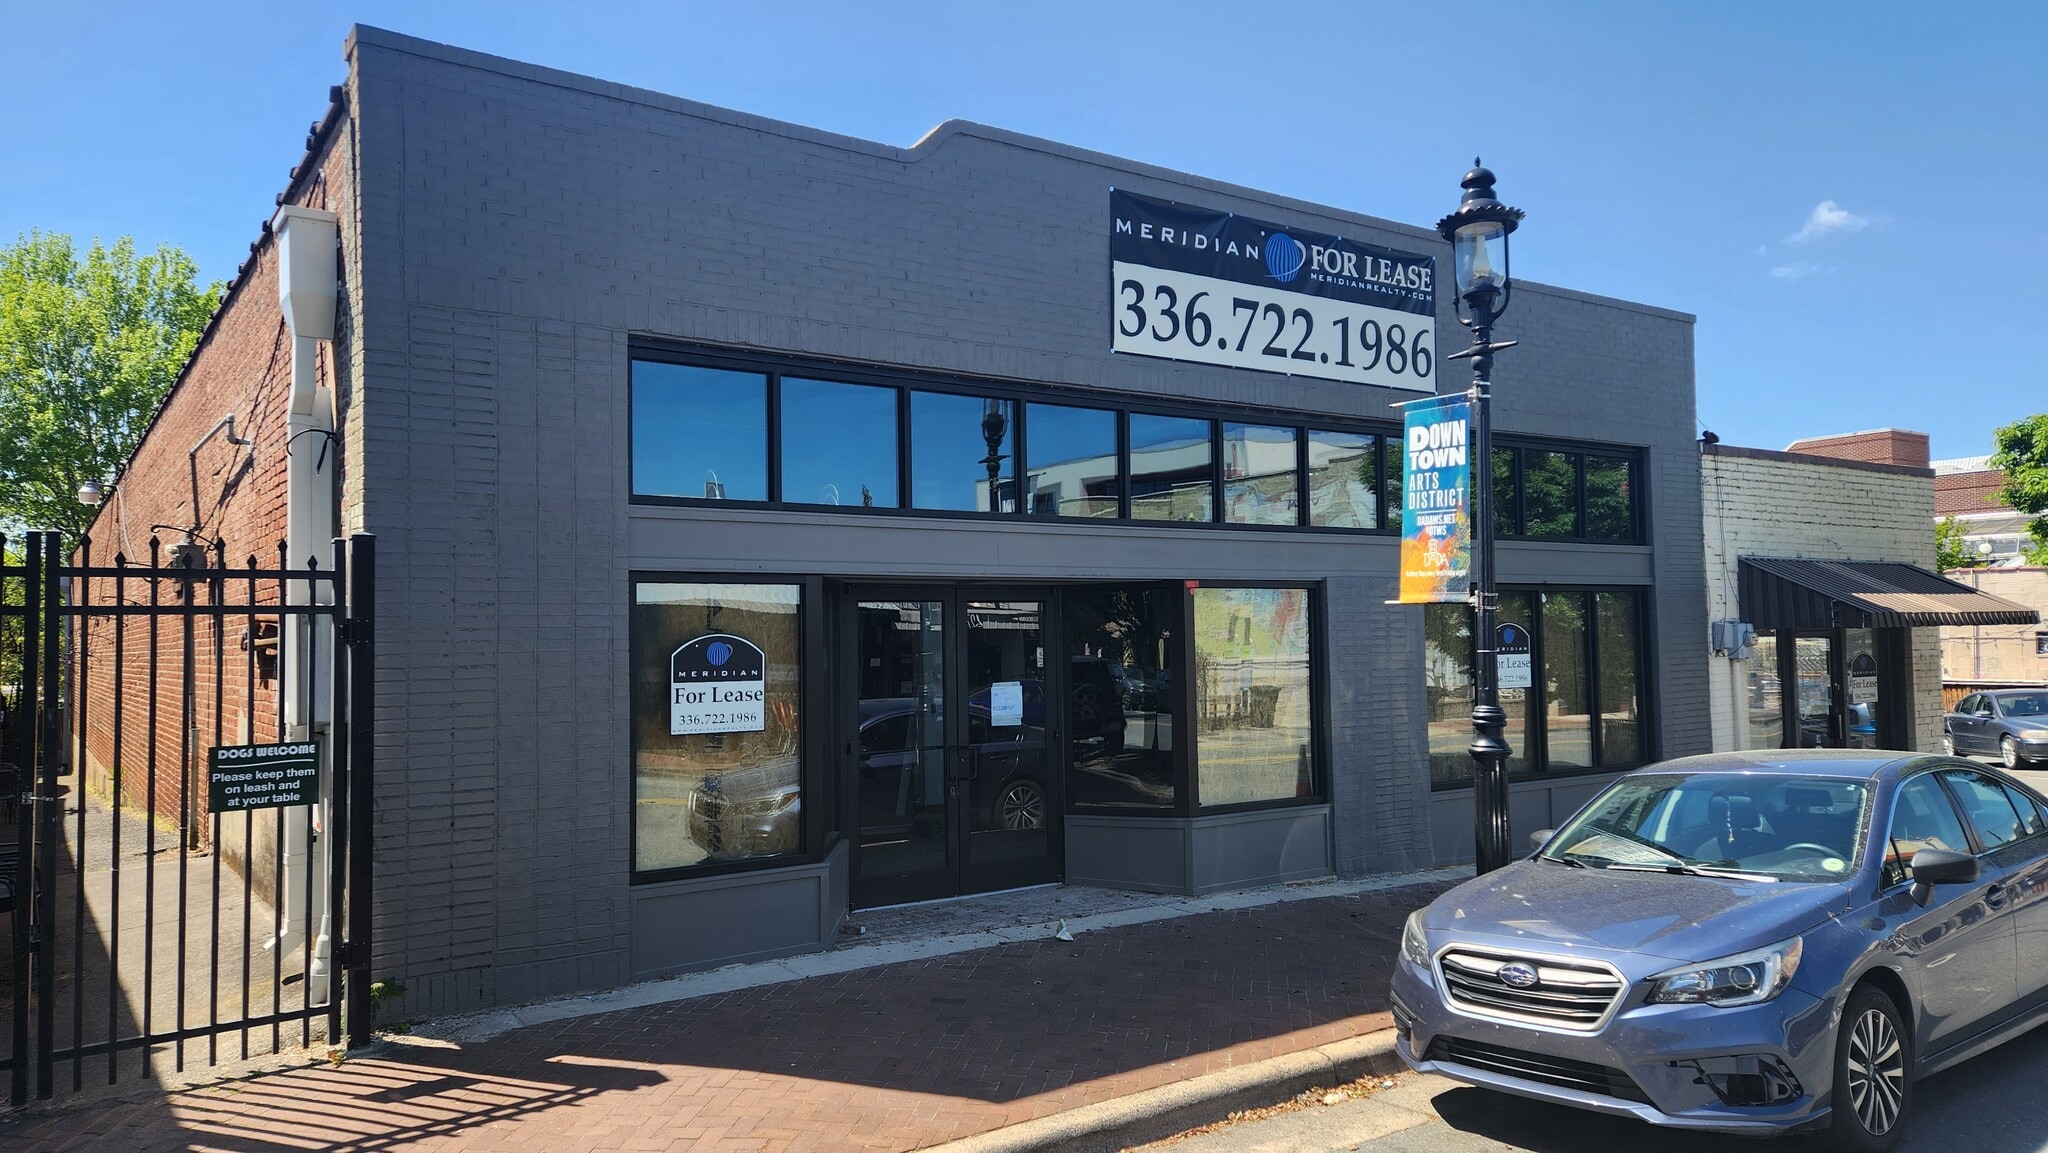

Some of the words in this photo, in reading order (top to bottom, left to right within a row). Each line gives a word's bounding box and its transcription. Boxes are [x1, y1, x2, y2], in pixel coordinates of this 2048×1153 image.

[1116, 217, 1259, 260] MERIDIAN
[1310, 244, 1359, 278] FOR
[1364, 255, 1432, 292] LEASE
[1310, 272, 1432, 301] MERIDIANREALTY.COM
[1119, 279, 1432, 378] 336.722.1986
[1409, 419, 1466, 452] DOWN
[1409, 445, 1466, 471] TOWN
[1409, 471, 1439, 491] ARTS
[1408, 487, 1464, 510] DISTRICT
[1416, 513, 1456, 526] DADAWS.NET
[1506, 657, 1531, 669] Lease
[678, 669, 759, 678] MERIDIAN
[1862, 679, 1877, 688] Lease
[673, 687, 706, 704] For
[711, 686, 763, 703] Lease
[679, 712, 757, 726] 336.722.1986
[217, 747, 254, 760] DOGS
[256, 744, 316, 757] WELCOME
[212, 772, 253, 783] Please
[255, 770, 284, 780] keep
[286, 767, 315, 778] them
[225, 786, 240, 794] on
[243, 782, 275, 793] leash
[278, 779, 300, 790] and
[227, 797, 240, 807] at
[242, 795, 270, 808] your
[272, 792, 301, 803] table
